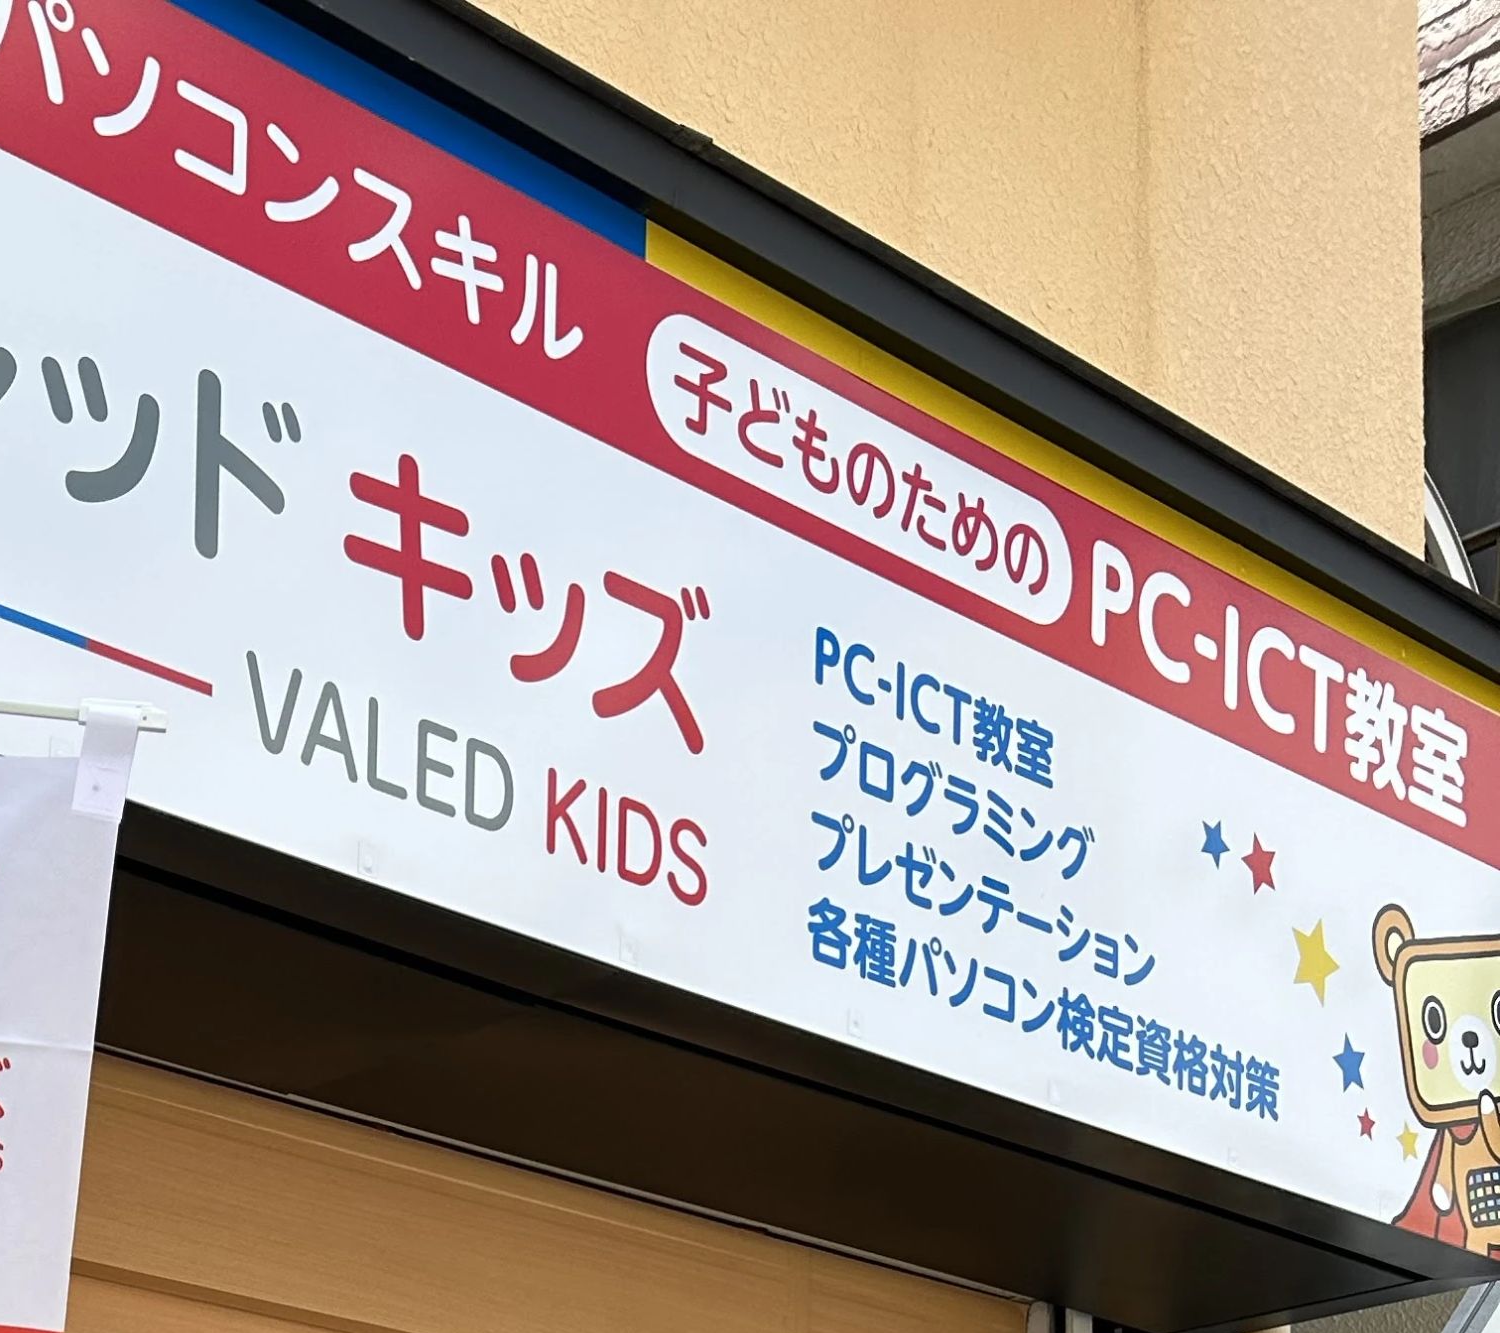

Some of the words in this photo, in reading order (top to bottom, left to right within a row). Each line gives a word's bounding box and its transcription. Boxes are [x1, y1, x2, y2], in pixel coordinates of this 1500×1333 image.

[343, 453, 711, 755] キッズ
[672, 341, 1049, 597] 子どものための
[1091, 537, 1469, 829] PC-ICT教室
[245, 649, 514, 832] VALED
[546, 766, 708, 907] KIDS
[811, 719, 1097, 882] プログラミング
[813, 625, 1056, 790] PC-ICT教室
[806, 897, 1282, 1123] 各種パソコン検定資格対策
[809, 809, 1157, 987] プレゼンテーション
